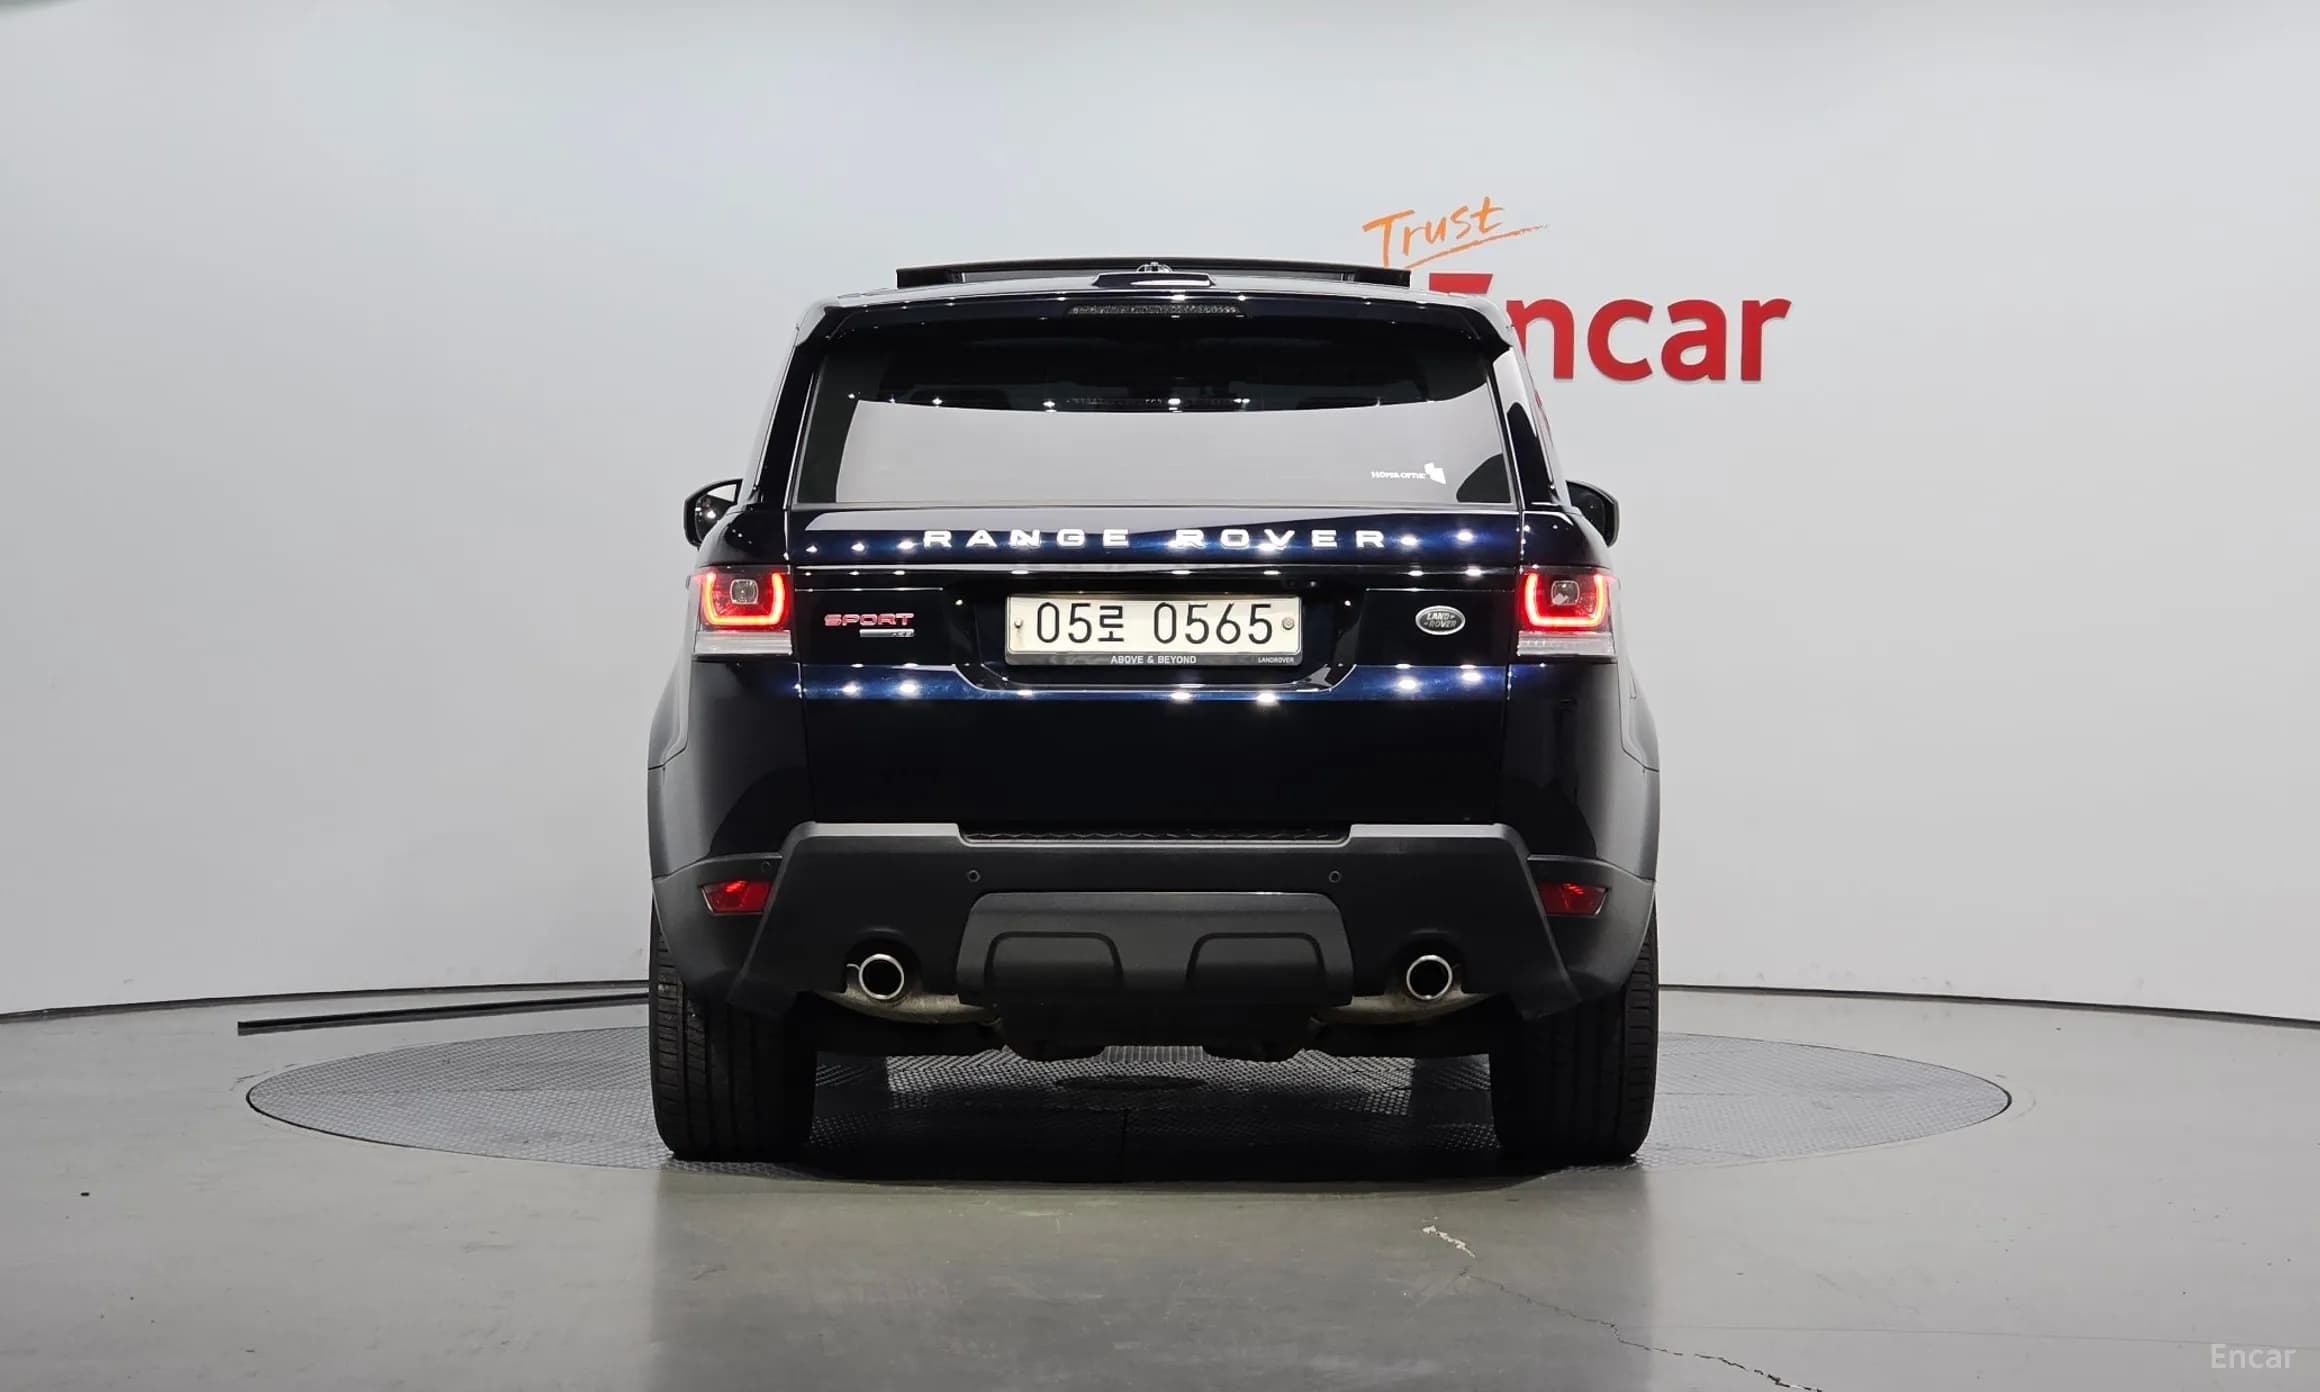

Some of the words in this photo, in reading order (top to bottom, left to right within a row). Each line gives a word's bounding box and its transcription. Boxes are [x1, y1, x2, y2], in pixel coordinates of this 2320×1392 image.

[1362, 196, 1504, 268] Trust
[1429, 273, 1792, 382] ncar
[923, 529, 1129, 548] RANGE
[1173, 529, 1384, 550] ROVER
[824, 613, 914, 626] SPORT
[1036, 602, 1125, 643] 05로
[1153, 602, 1273, 644] 0565
[1110, 655, 1143, 664] ABOVE
[1147, 655, 1154, 664] &
[1157, 655, 1197, 664] BEYOND
